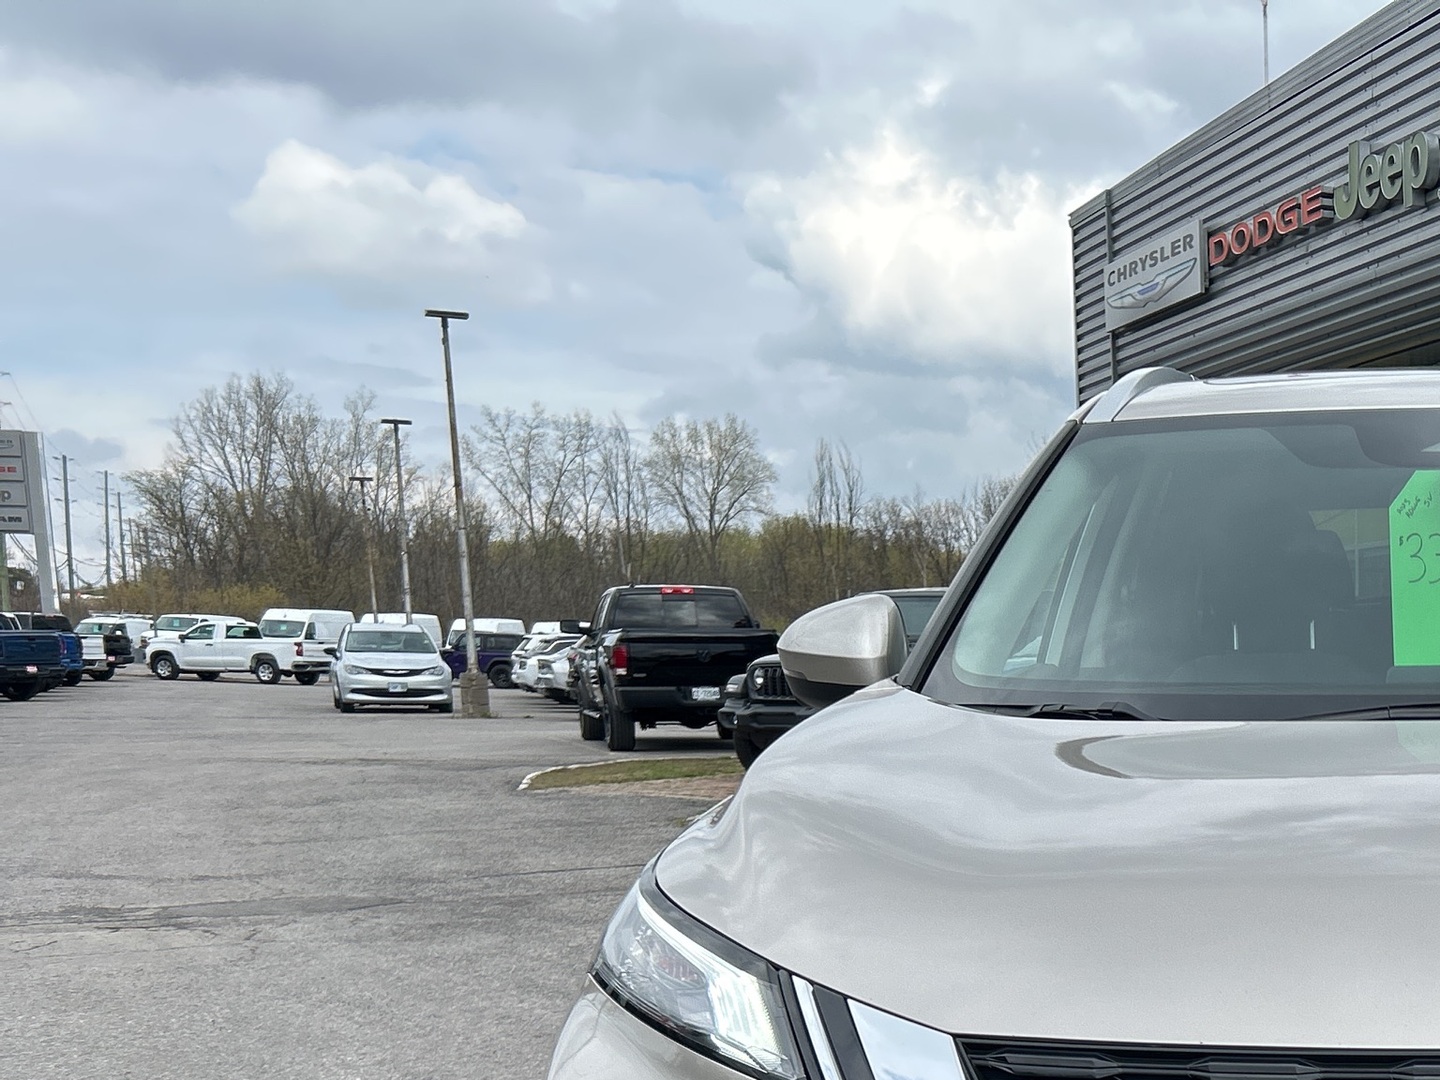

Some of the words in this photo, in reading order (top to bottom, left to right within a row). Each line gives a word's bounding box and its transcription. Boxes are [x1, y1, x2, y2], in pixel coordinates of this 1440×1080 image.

[1333, 131, 1432, 220] Jeep
[1107, 232, 1195, 287] CHRYSLER
[1209, 185, 1323, 266] DODGE
